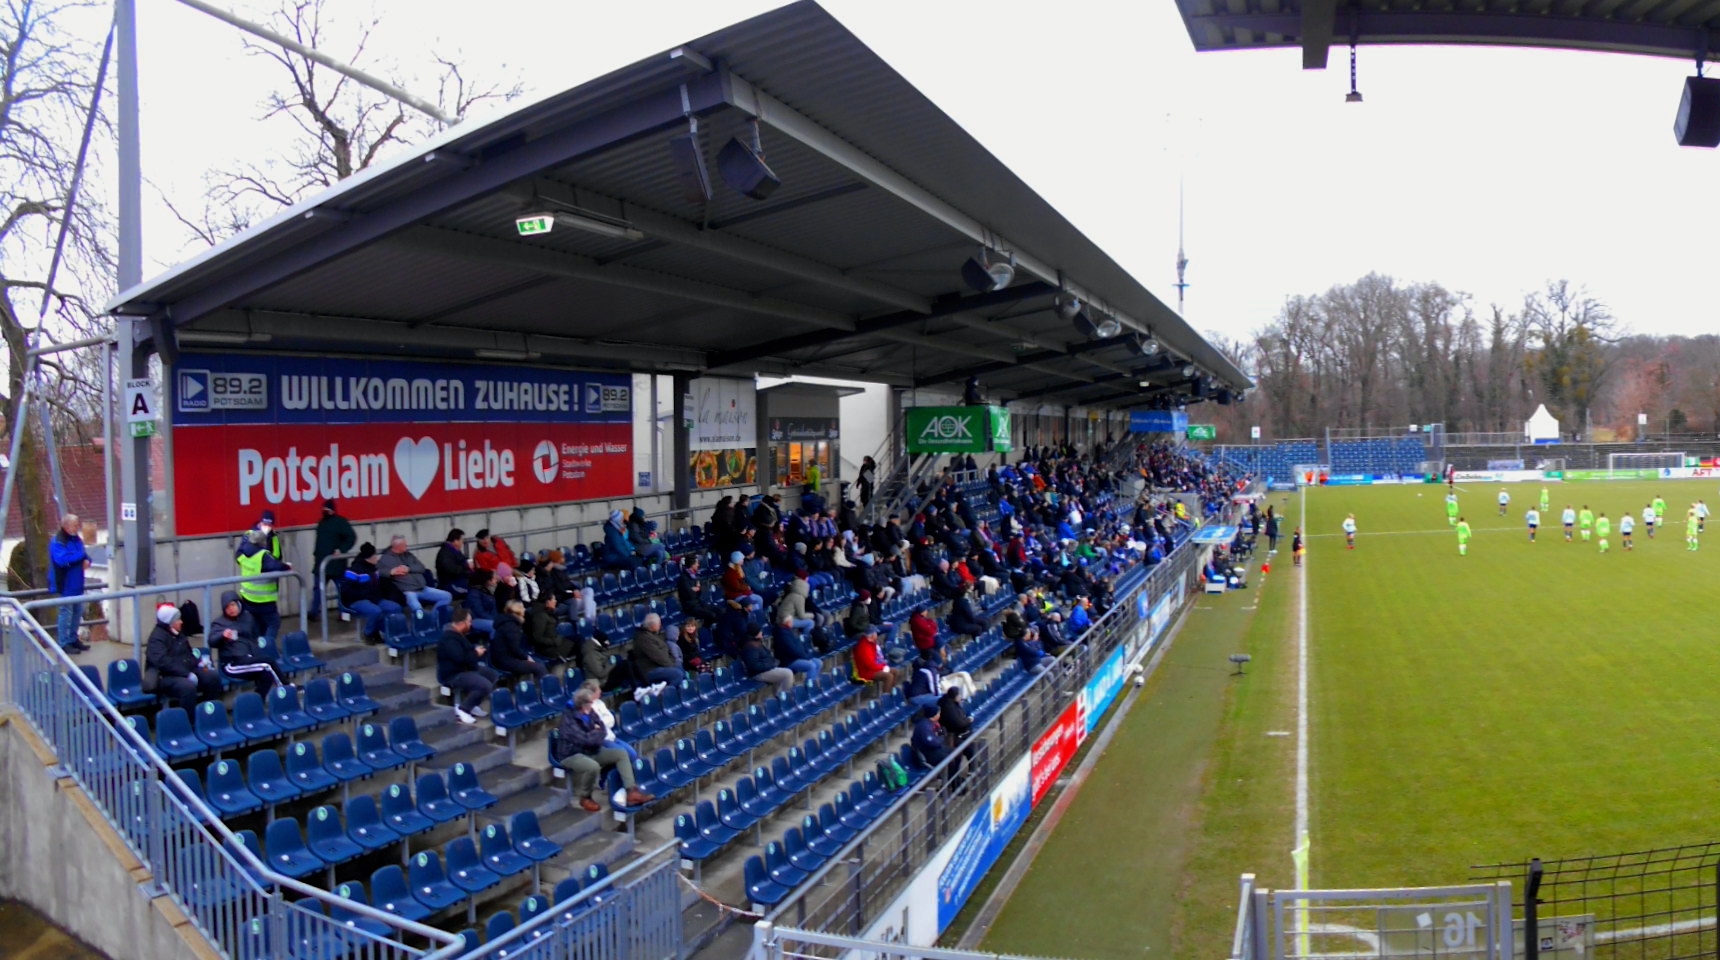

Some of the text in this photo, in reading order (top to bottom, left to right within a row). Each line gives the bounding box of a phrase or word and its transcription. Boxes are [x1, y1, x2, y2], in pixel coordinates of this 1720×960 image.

[127, 381, 151, 389] BLOCK
[213, 377, 263, 395] 89.2
[280, 375, 465, 410] WILLKOMMEN
[213, 398, 263, 406] POTSDAM
[602, 388, 628, 401] 89.2
[132, 393, 149, 415] A
[920, 415, 973, 438] AOK
[561, 442, 628, 457] Energie und Wasser
[238, 439, 515, 506] Potsdam Liebe
